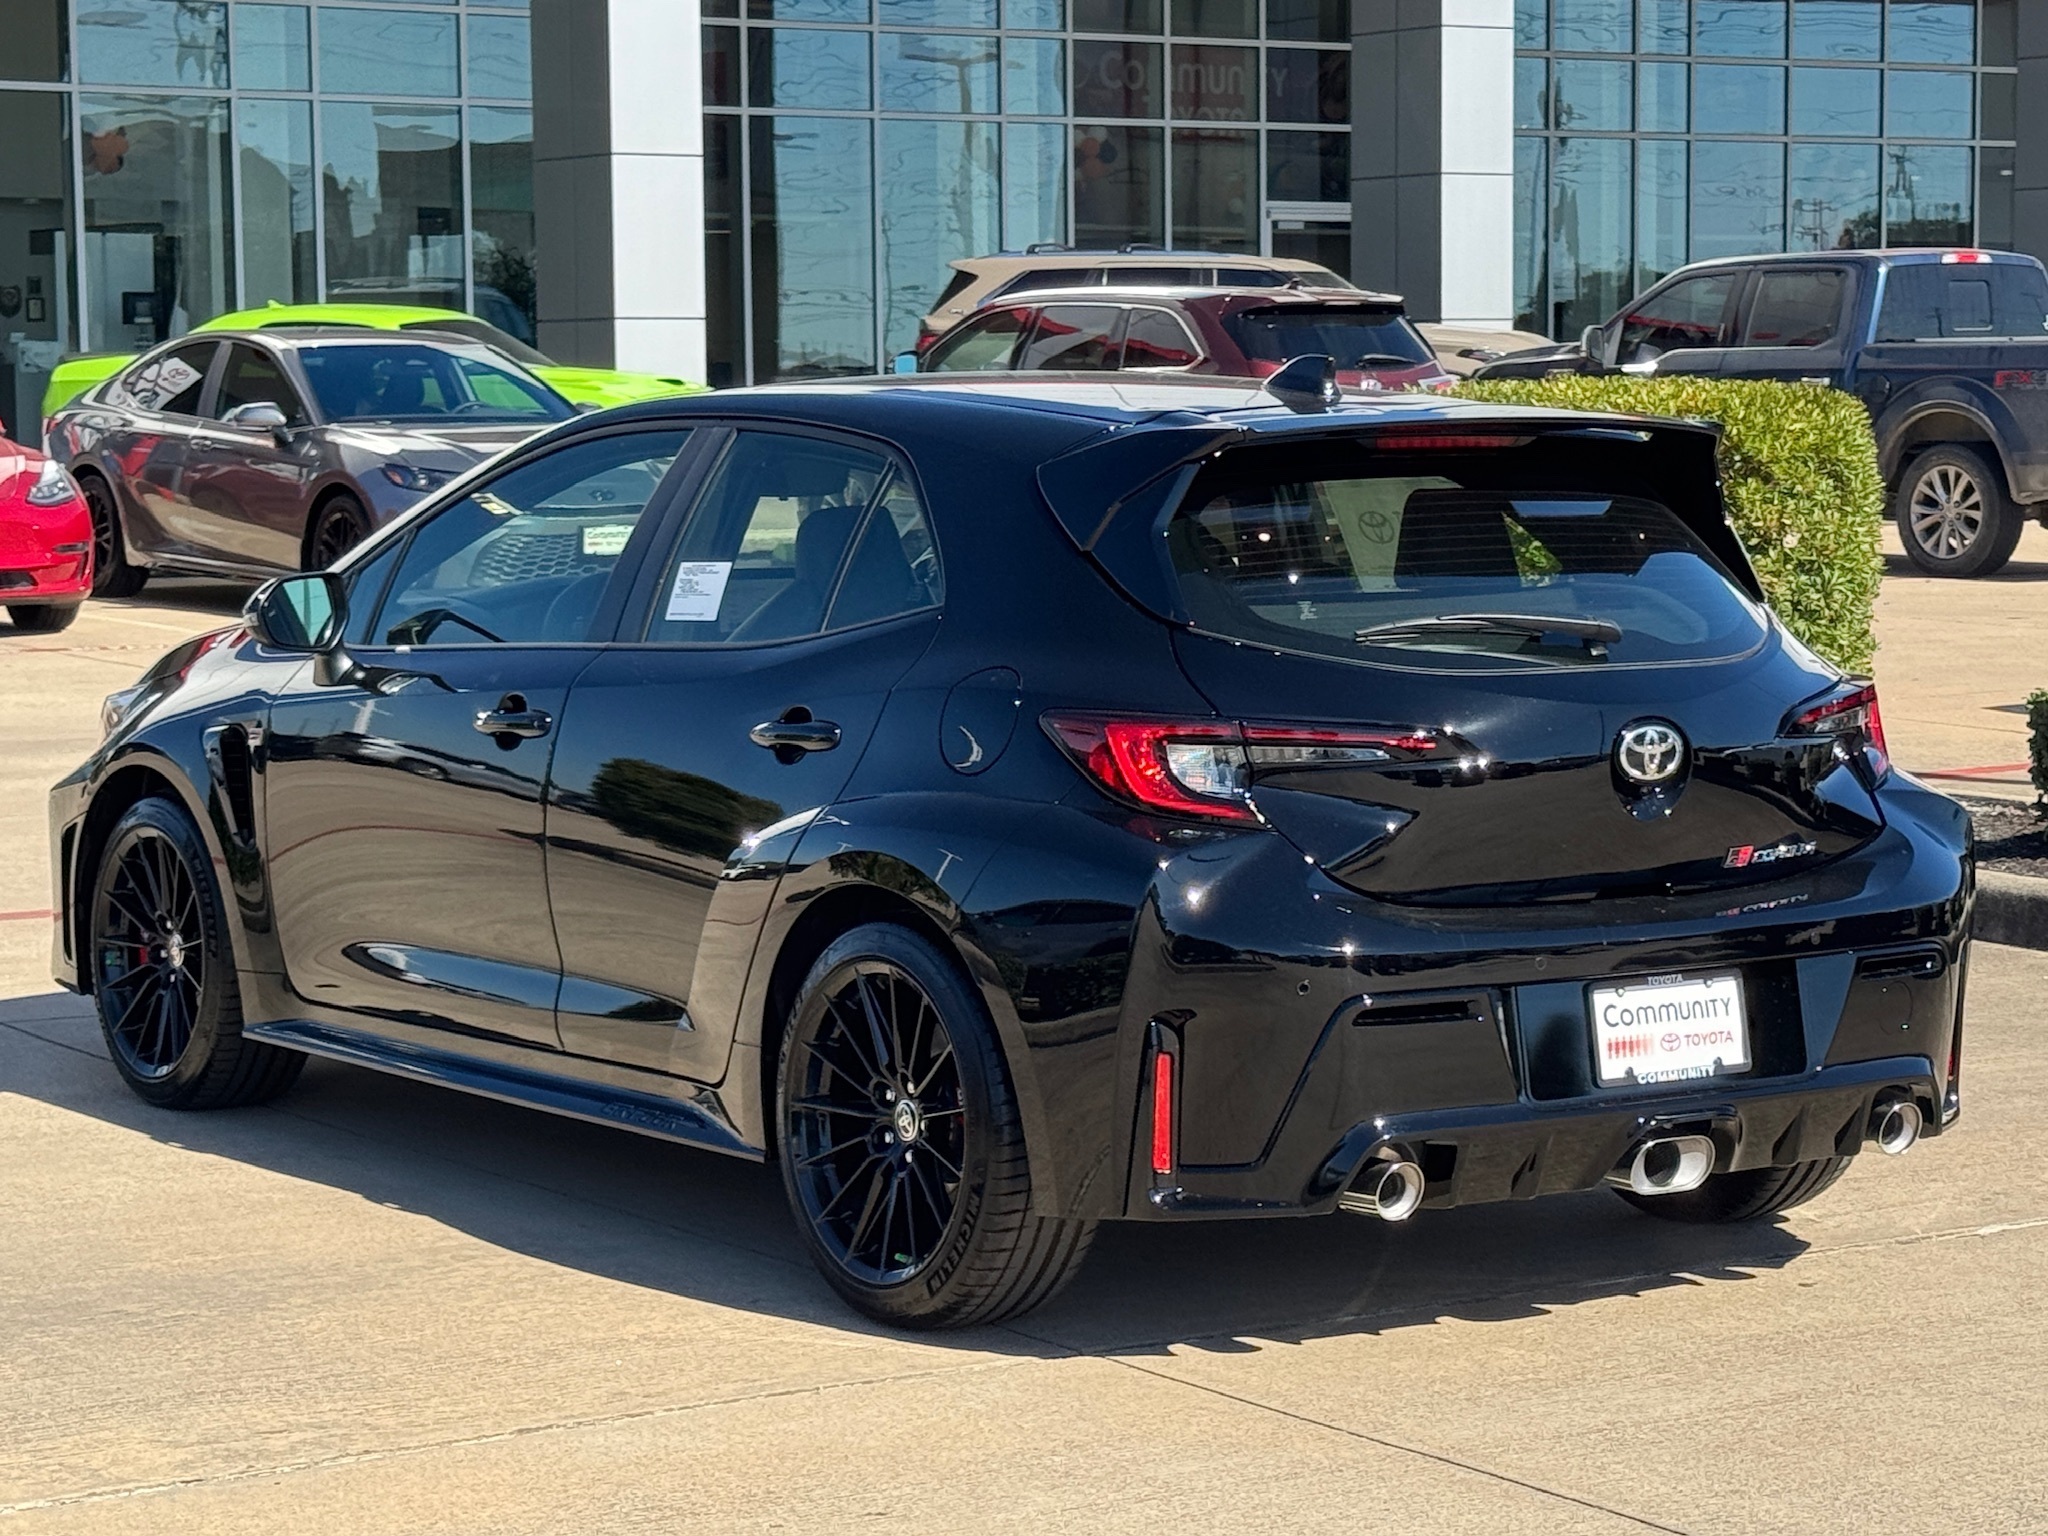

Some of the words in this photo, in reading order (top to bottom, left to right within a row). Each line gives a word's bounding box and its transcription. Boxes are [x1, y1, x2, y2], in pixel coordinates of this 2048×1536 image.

[1647, 973, 1684, 986] TOYOTA
[1684, 1030, 1734, 1047] TOYOTA
[1637, 1064, 1716, 1085] COMMUNITY
[928, 1190, 981, 1295] MICHELIN
